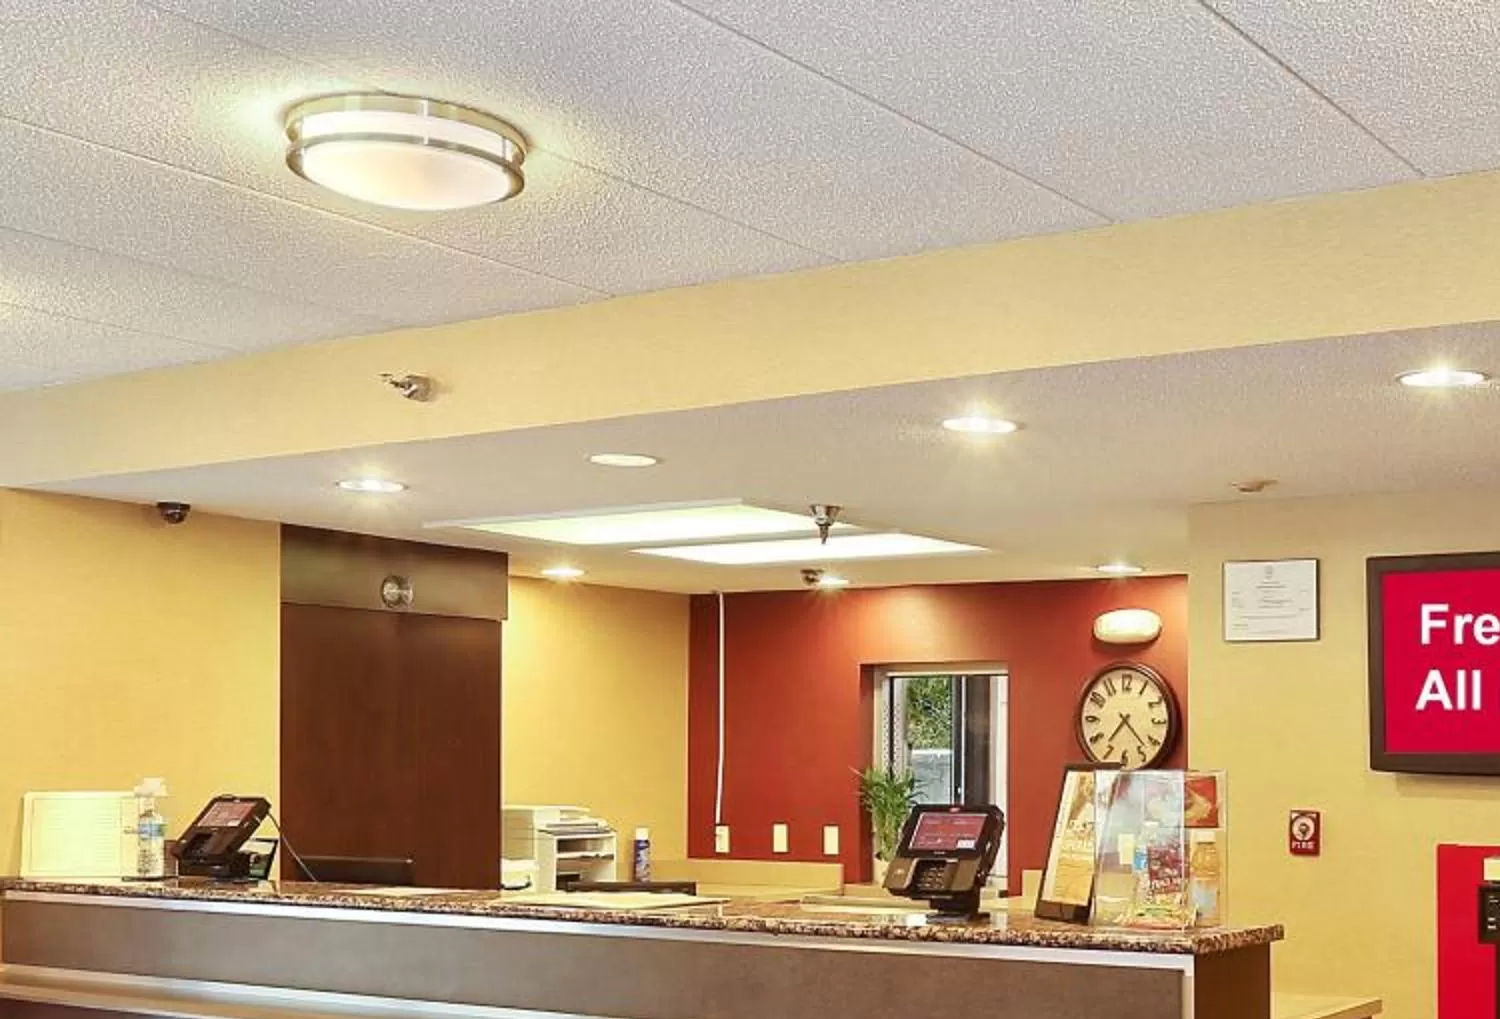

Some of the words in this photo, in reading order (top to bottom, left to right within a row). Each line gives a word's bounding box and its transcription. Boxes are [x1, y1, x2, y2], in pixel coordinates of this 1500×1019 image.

[1121, 673, 1133, 692] 12
[1415, 669, 1481, 711] All
[1103, 744, 1114, 760] 7
[1137, 745, 1147, 762] 5
